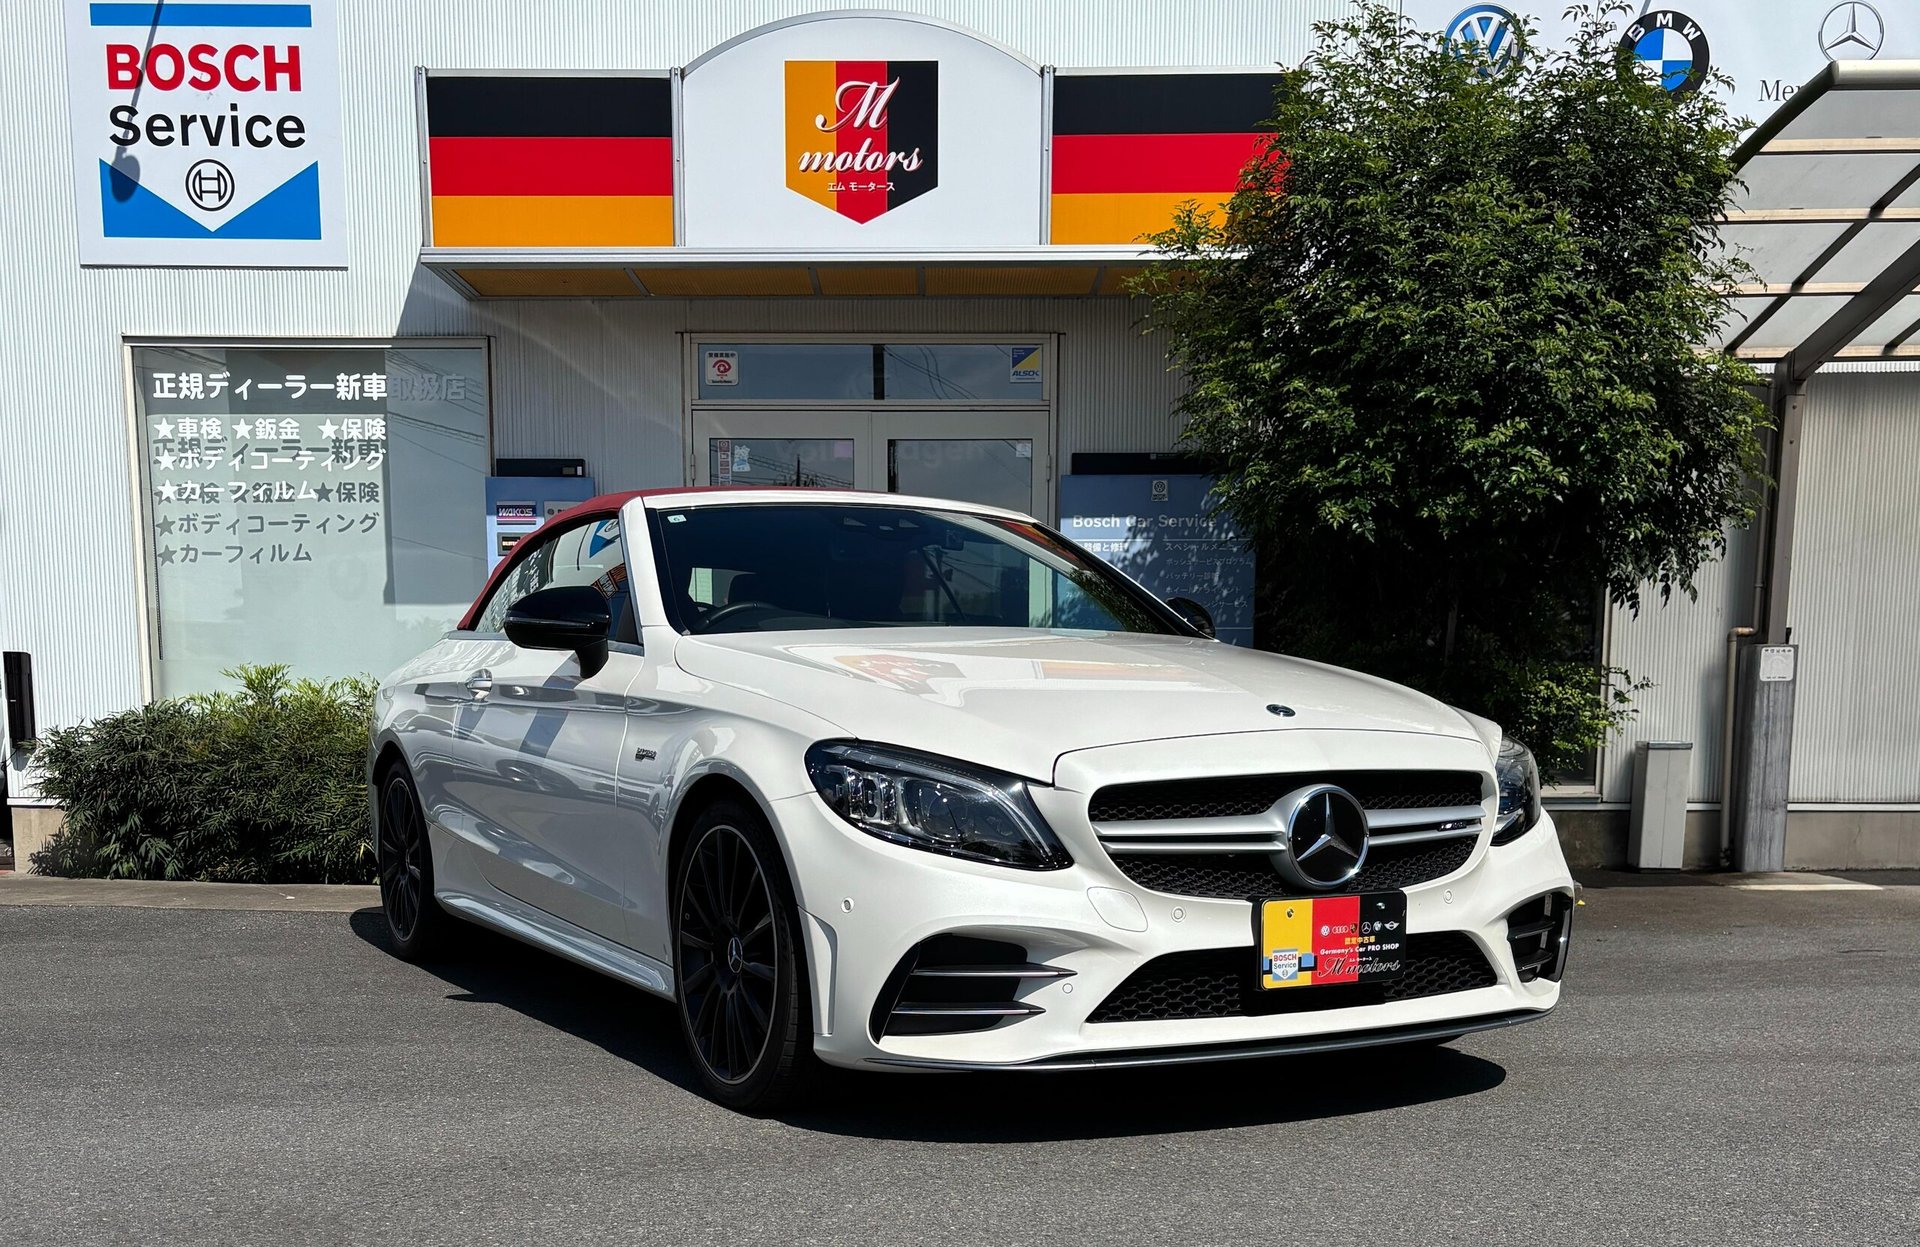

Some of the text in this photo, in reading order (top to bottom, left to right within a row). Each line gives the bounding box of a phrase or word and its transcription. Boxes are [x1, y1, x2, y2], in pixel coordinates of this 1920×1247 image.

[1627, 13, 1701, 43] BMW
[106, 43, 303, 93] BOSCH
[815, 76, 900, 132] M
[108, 103, 306, 149] Service
[798, 137, 924, 173] motors
[827, 181, 896, 192] エム モータース
[1072, 513, 1217, 528] Bosch Car Service
[1273, 953, 1297, 962] BOSCH
[1320, 942, 1400, 956] Germany's Car PRO SHOP
[1273, 961, 1297, 969] Service
[1318, 954, 1348, 978] M
